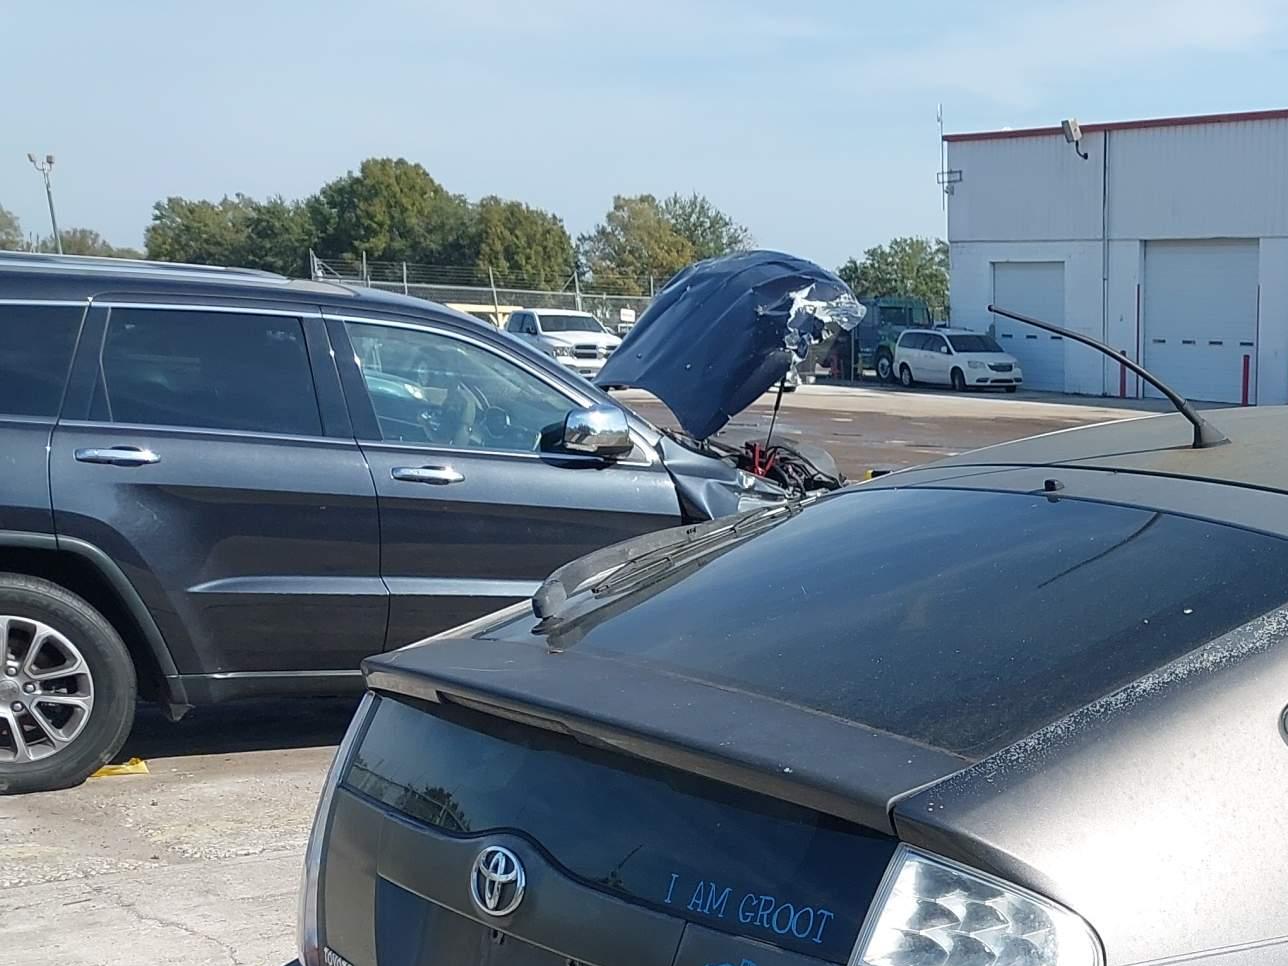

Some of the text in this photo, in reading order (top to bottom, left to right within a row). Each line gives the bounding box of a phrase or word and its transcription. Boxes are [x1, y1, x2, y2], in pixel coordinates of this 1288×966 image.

[663, 872, 835, 944] I AM GROOT
